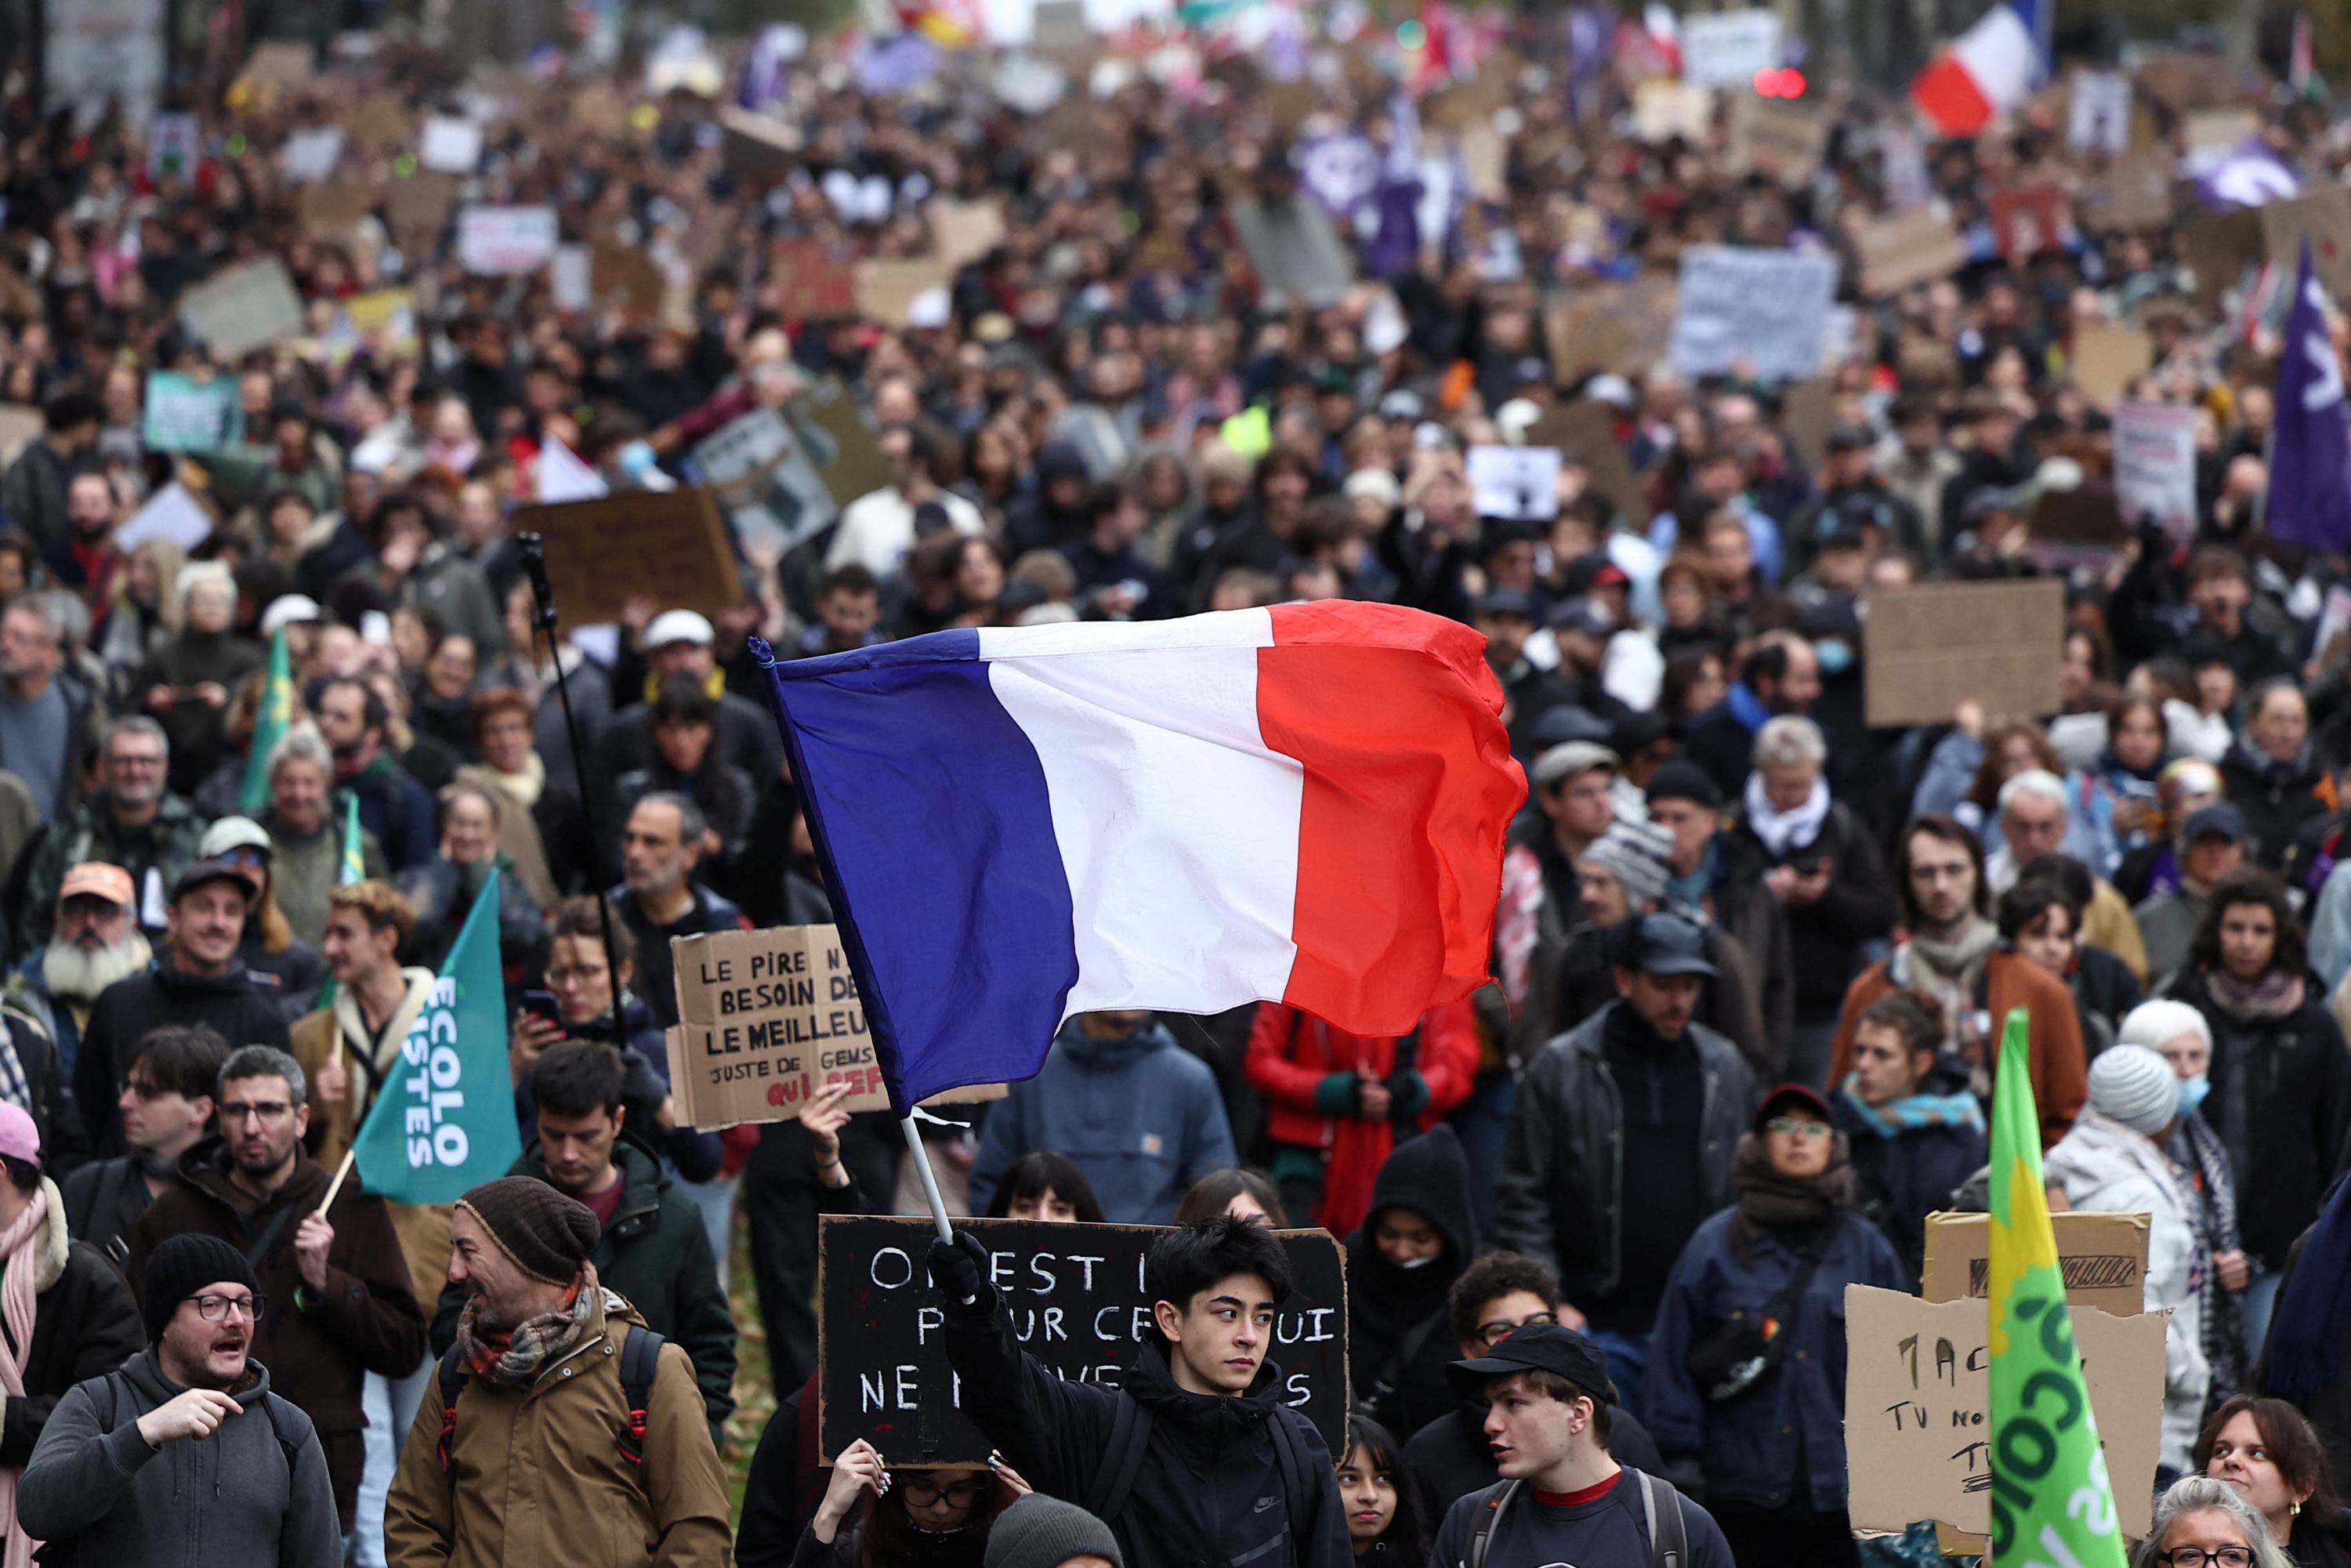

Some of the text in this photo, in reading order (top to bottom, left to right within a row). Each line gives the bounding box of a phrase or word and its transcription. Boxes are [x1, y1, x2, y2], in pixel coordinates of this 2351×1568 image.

[701, 961, 732, 984] LE
[828, 947, 840, 971] N
[705, 1010, 867, 1055] LE MEILLEU
[426, 976, 469, 1167] ECOLO
[710, 1060, 770, 1085] JUSTE
[777, 1057, 801, 1074] DE
[766, 1073, 811, 1107] QUI
[401, 1016, 433, 1169] ISTES
[871, 1247, 934, 1289] O
[918, 1305, 1335, 1345] PUR CE UI
[860, 1365, 919, 1414] NE
[1952, 1410, 1991, 1429] NO
